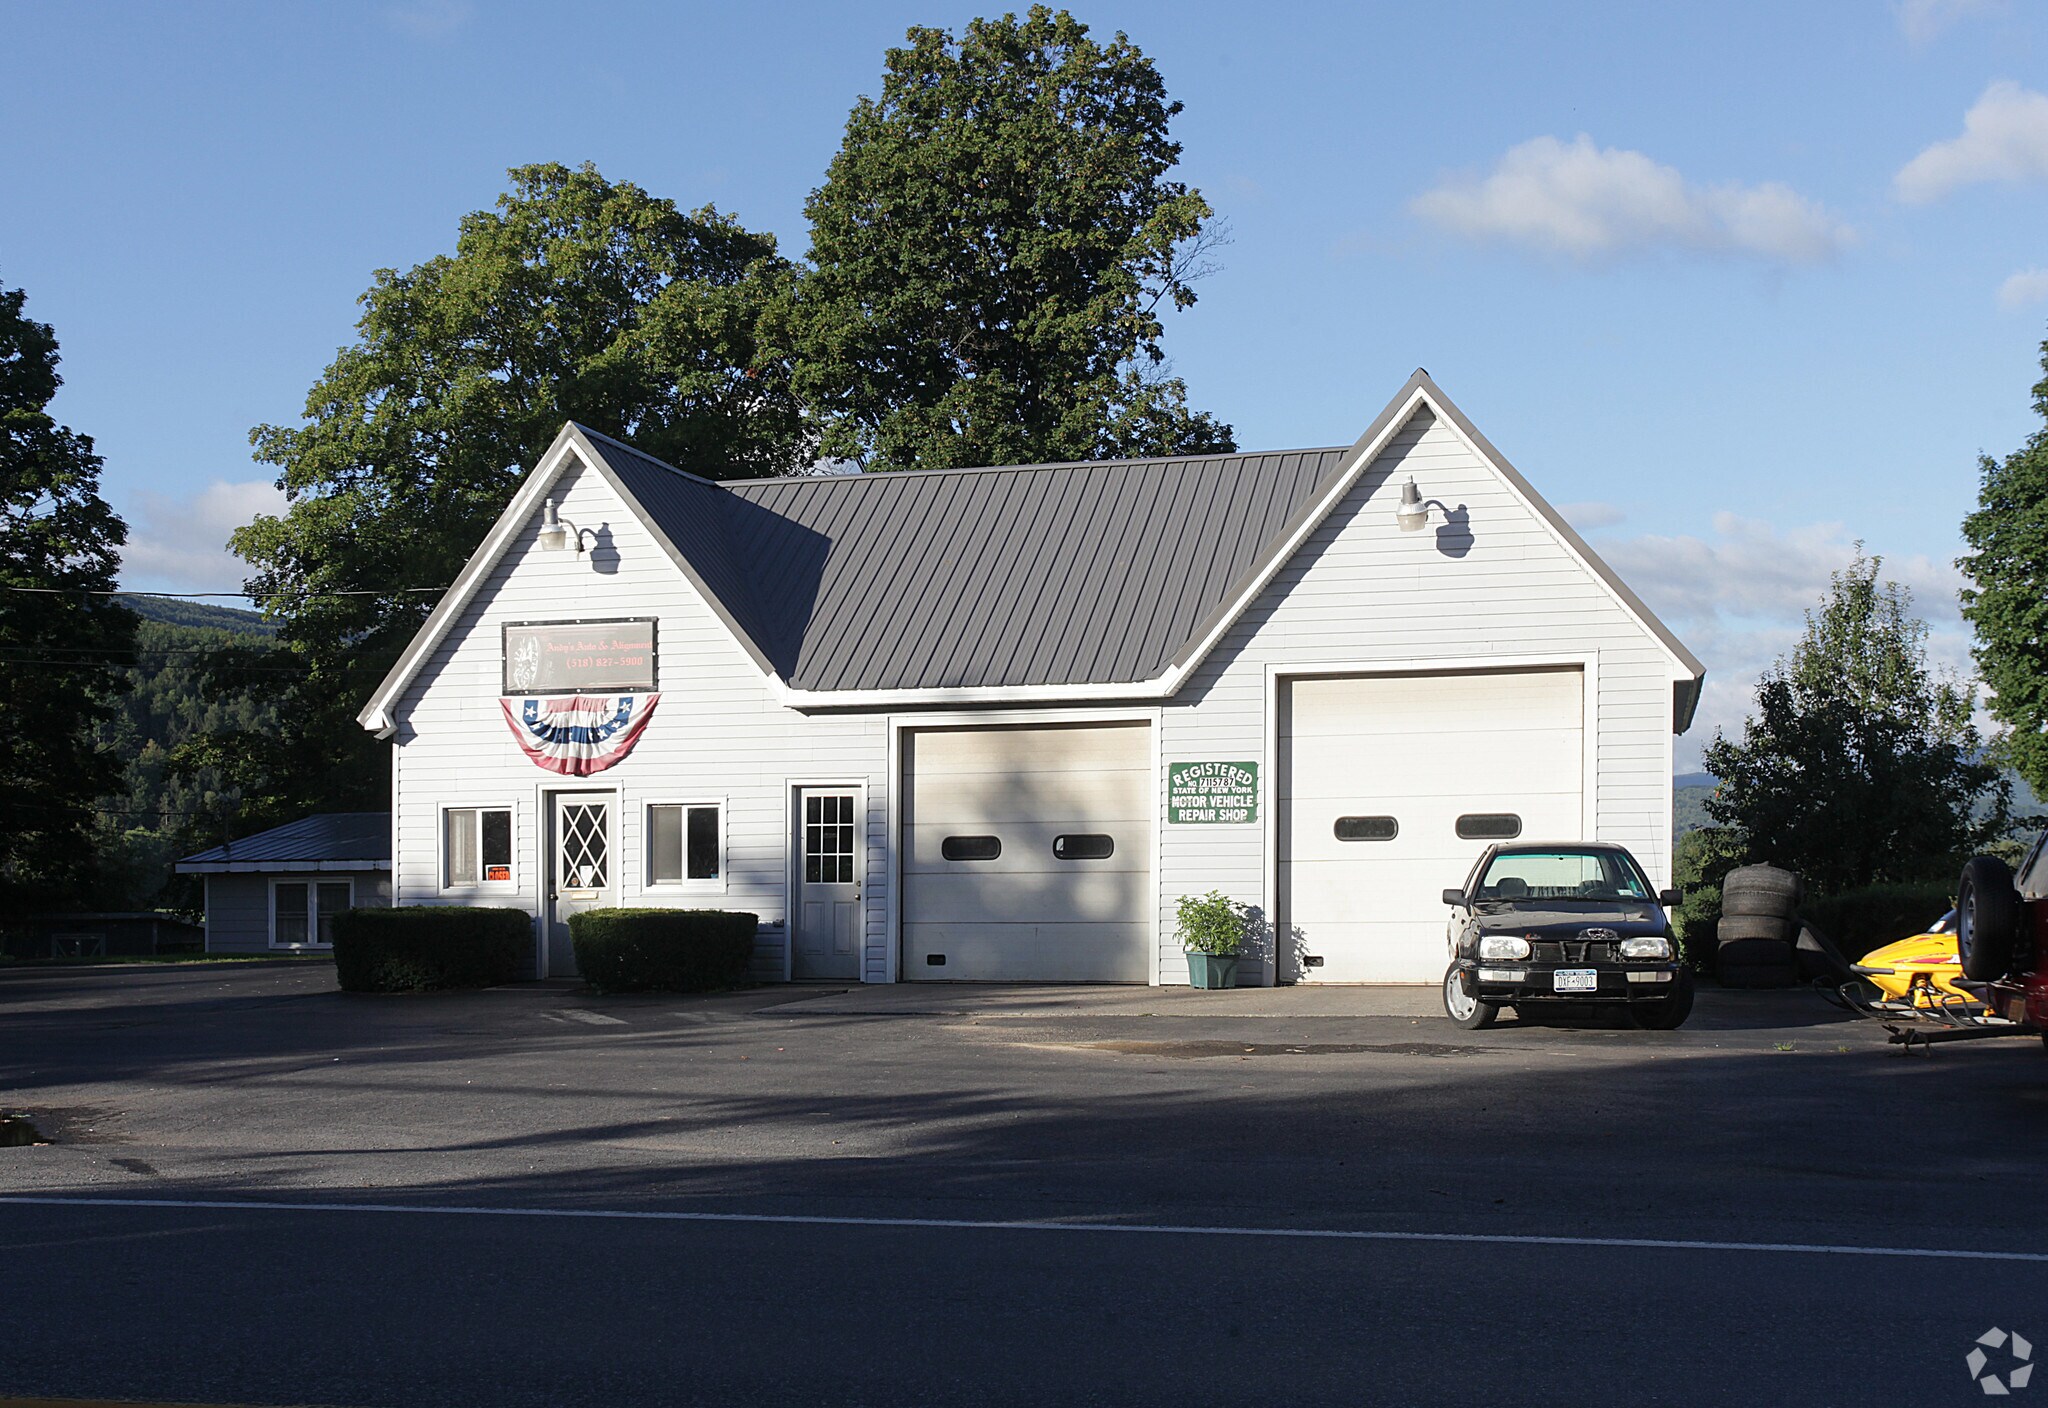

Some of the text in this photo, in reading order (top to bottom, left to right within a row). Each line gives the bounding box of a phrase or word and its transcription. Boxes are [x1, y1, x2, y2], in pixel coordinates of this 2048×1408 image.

[598, 640, 608, 650] &
[566, 656, 643, 668] (518) 827-5900
[1173, 763, 1252, 786] REGISTERED
[1200, 778, 1234, 786] 7115787
[1172, 796, 1254, 808] MOTOR VEHICLE
[1179, 809, 1248, 821] REPAIR SHOP
